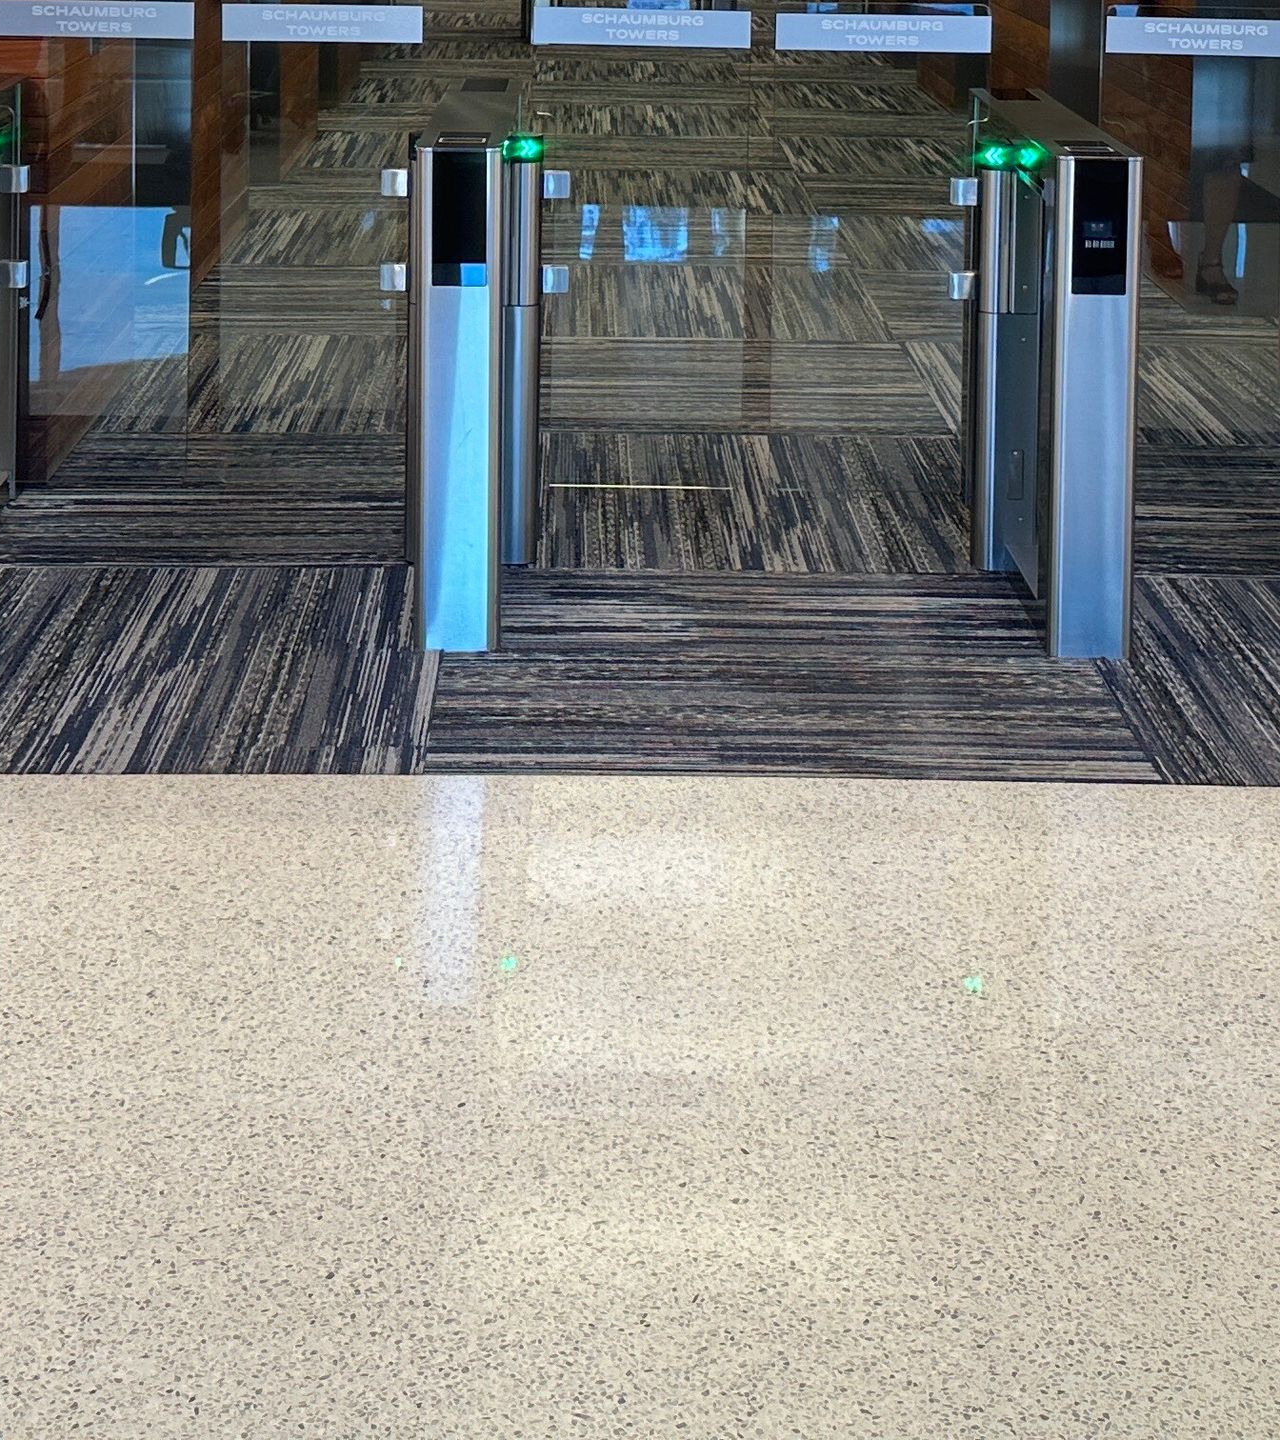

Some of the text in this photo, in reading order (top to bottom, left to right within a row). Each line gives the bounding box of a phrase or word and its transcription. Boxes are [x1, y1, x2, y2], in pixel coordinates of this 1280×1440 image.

[31, 5, 158, 19] SCHAUMBURG
[261, 9, 386, 22] SCHAUMBURG
[56, 20, 133, 33] TOWERS
[581, 13, 705, 27] SCHAUMBURG
[821, 19, 944, 32] SCHAUMBURG
[286, 24, 361, 37] TOWERS
[606, 28, 680, 41] TOWERS
[1144, 22, 1269, 37] SCHAUMBURG
[845, 34, 920, 46] TOWERS
[1168, 38, 1244, 51] TOWERS
